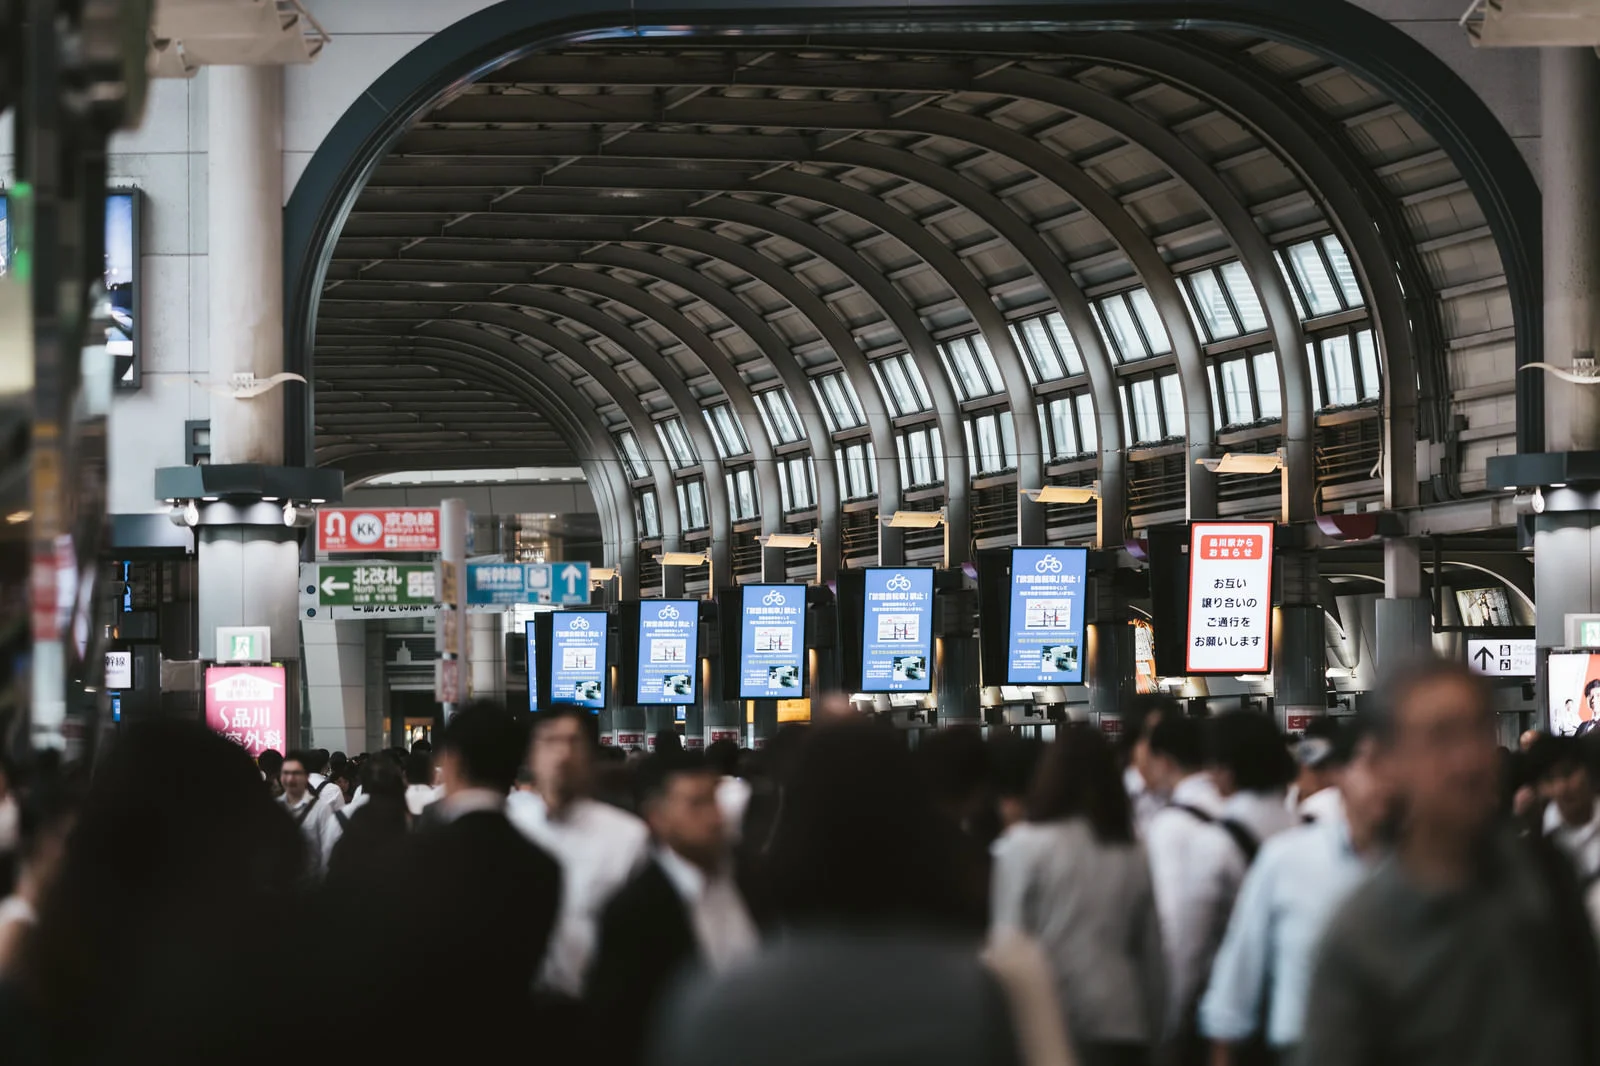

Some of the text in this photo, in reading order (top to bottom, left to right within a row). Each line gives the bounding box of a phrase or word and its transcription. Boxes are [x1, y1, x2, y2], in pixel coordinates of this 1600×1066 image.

[384, 512, 435, 526] 京急線
[356, 523, 376, 536] KK
[1209, 538, 1254, 548] 品川駅から
[1209, 548, 1253, 557] お知らせ
[352, 567, 403, 585] 北改札
[1213, 578, 1247, 589] お互い
[1201, 597, 1258, 608] 譲り合いの
[1206, 616, 1251, 627] ご通行を
[1194, 636, 1262, 647] お願いします
[104, 655, 126, 667] 幹線
[231, 706, 271, 729] 品川
[218, 729, 282, 751] 容外科
